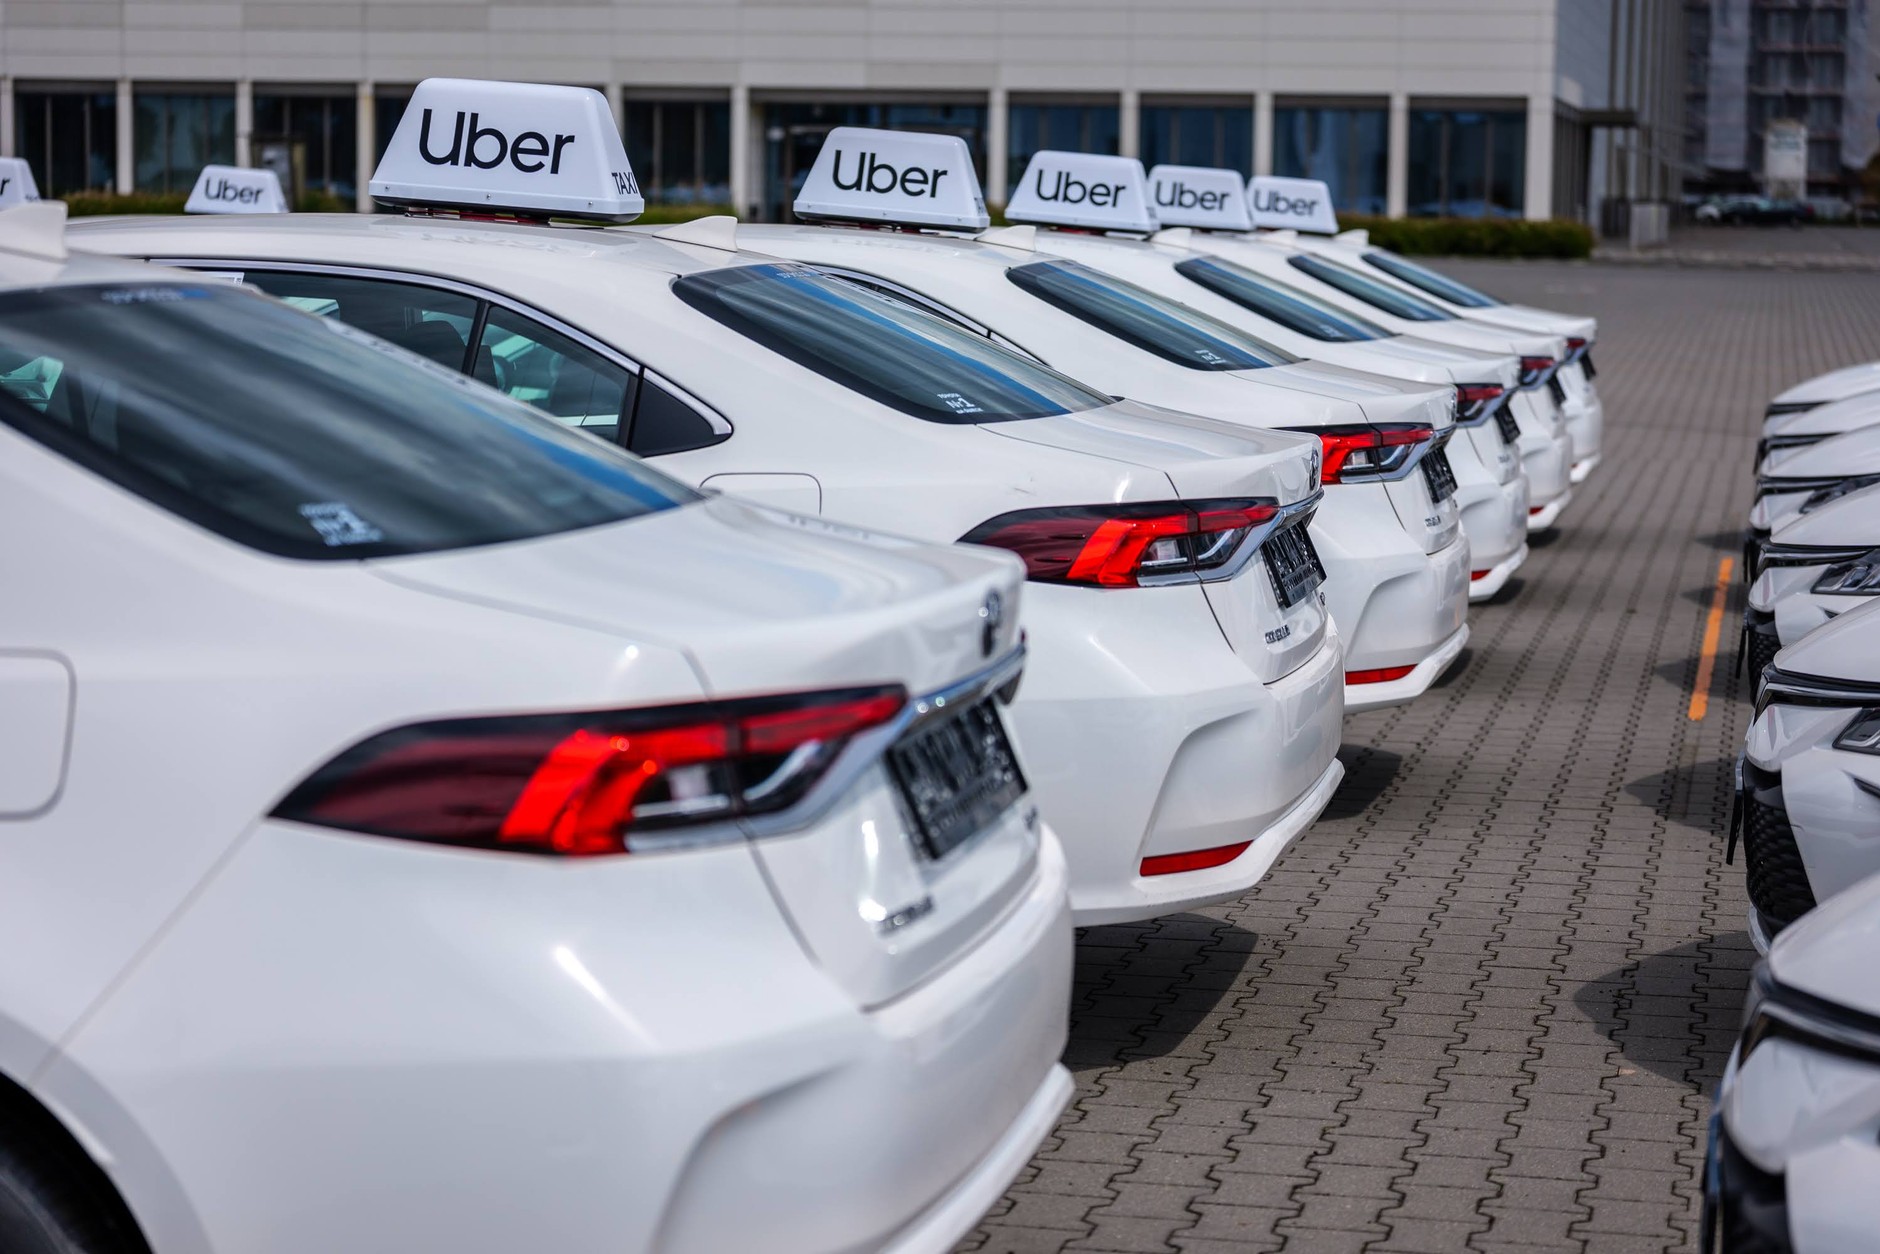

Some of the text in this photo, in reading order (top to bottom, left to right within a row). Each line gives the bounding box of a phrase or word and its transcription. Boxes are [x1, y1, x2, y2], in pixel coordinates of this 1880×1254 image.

[419, 109, 576, 175] Uber
[611, 172, 638, 195] TAXI
[832, 150, 949, 198] Uber
[1036, 168, 1127, 208] Uber
[204, 177, 265, 205] Uber
[1155, 180, 1230, 211] Uber
[1254, 189, 1317, 216] Uber
